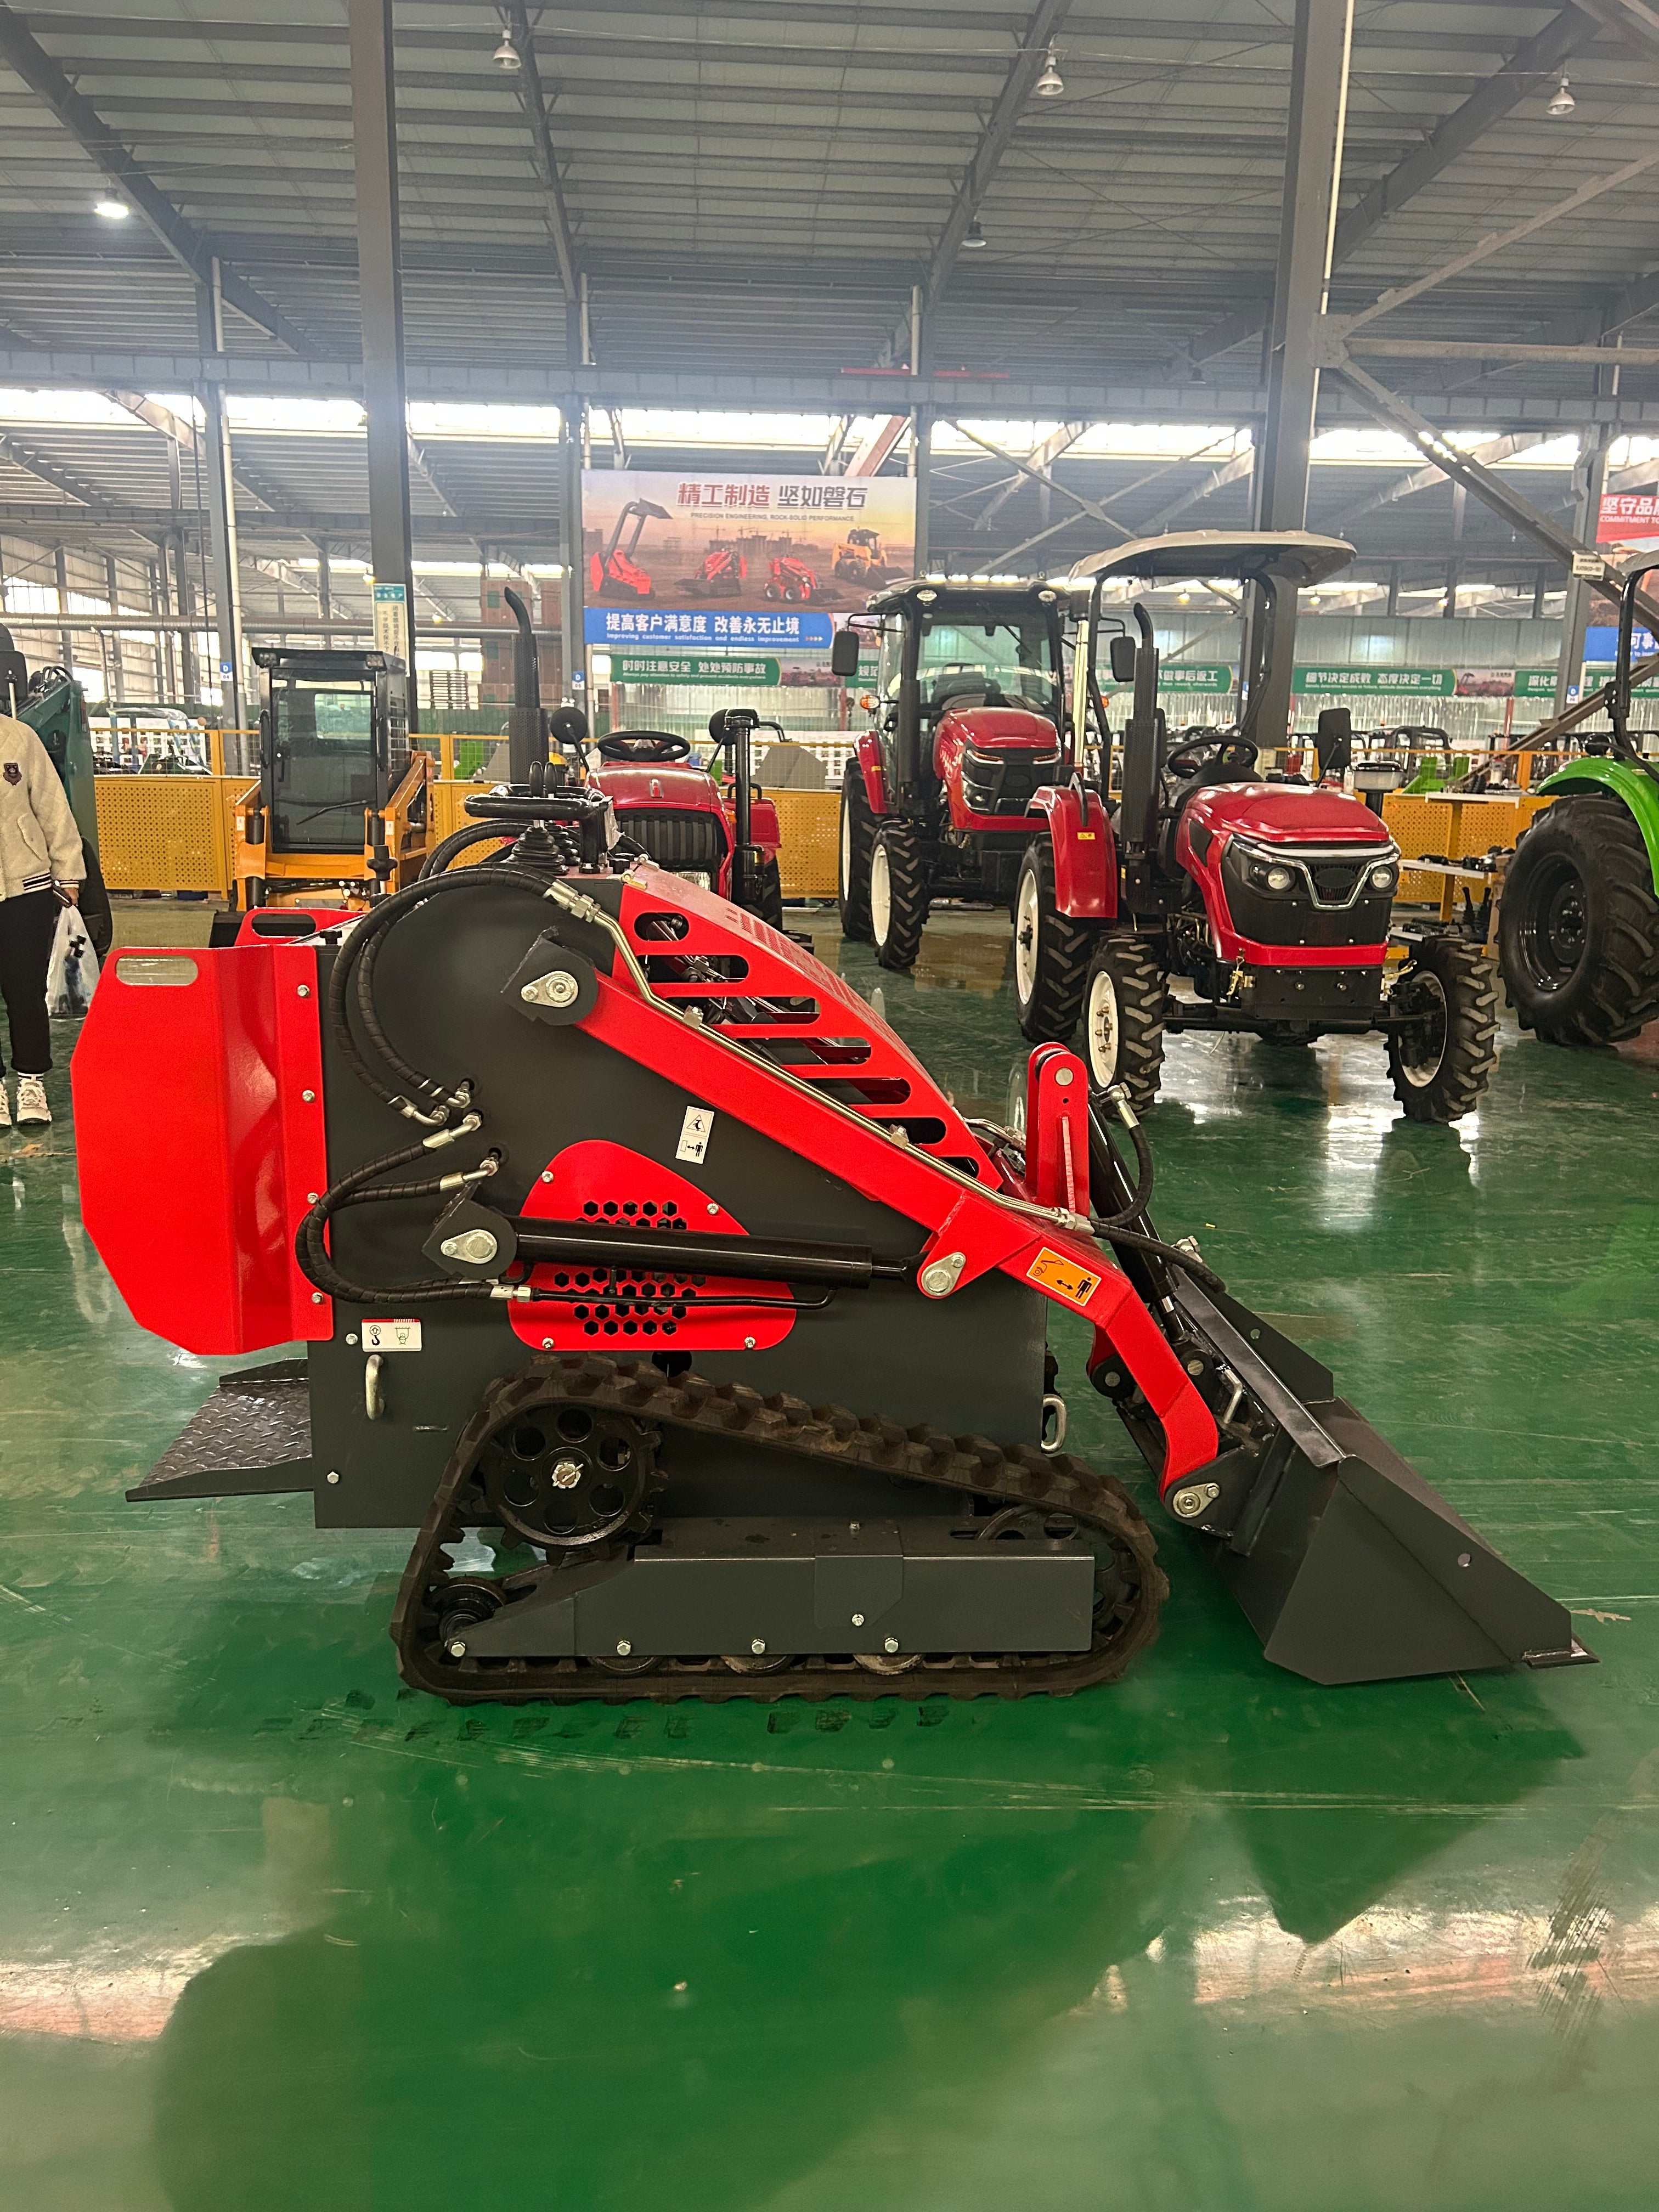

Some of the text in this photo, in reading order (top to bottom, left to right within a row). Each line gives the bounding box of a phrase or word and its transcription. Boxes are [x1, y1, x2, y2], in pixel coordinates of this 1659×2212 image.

[677, 483, 868, 508] 精工制造 坚如磐石
[1600, 516, 1650, 524] COMMITMENT
[606, 613, 800, 634] 提高客户满意度 改善永无止境
[623, 660, 766, 674] 时时注意安全 处处预防事故
[1306, 672, 1443, 685] 细节决定成败 态度决定一切
